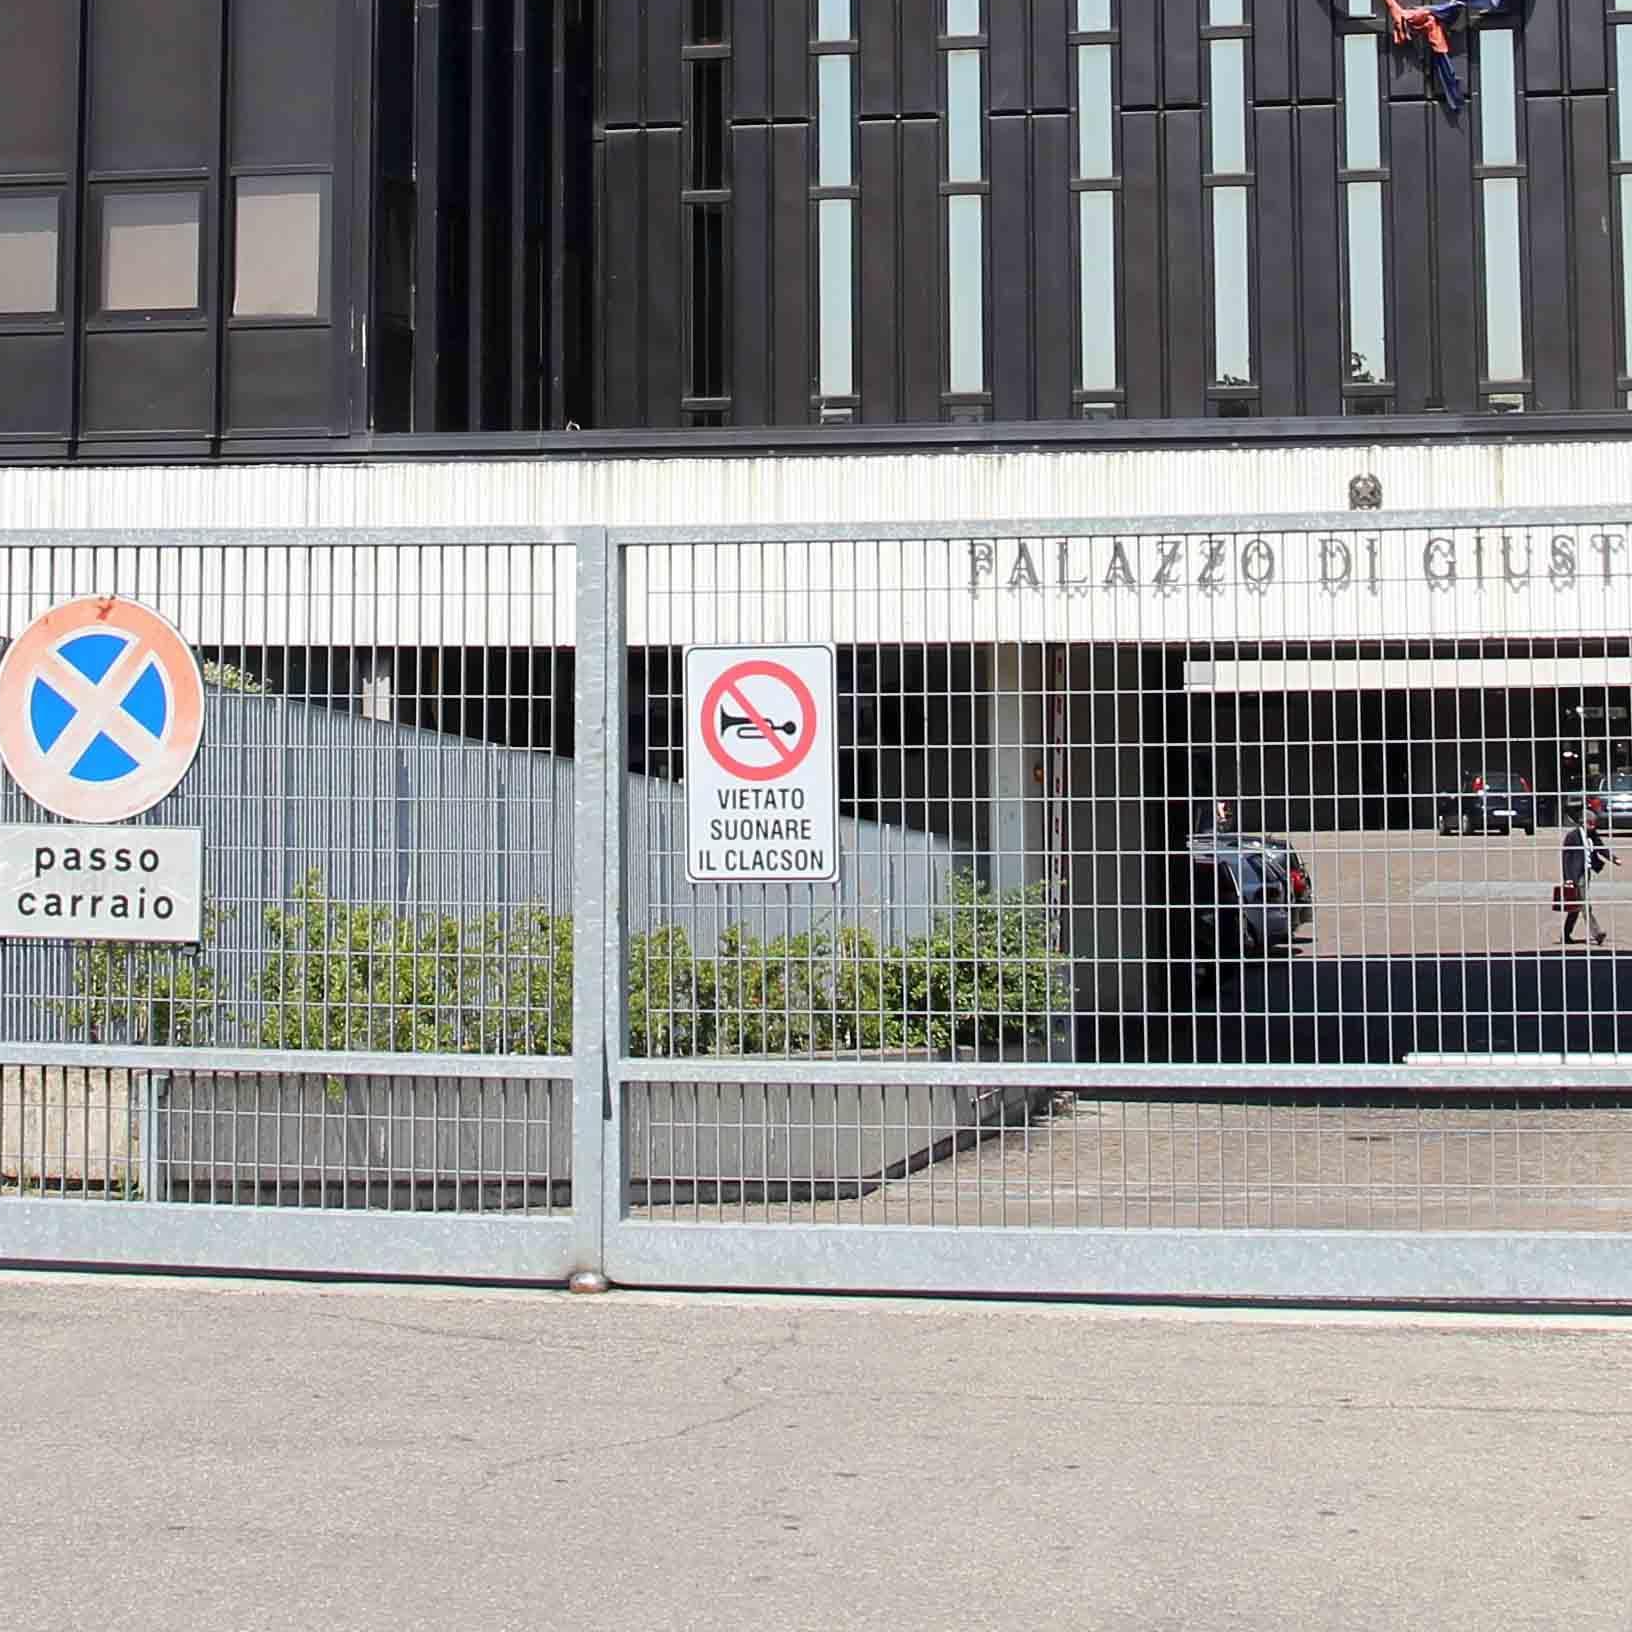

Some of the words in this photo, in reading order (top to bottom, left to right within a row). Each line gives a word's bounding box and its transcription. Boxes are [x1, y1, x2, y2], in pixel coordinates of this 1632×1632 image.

[966, 538, 1276, 590] PALAZZO
[1317, 535, 1381, 590] DI
[717, 787, 805, 810] VIETATO
[710, 818, 812, 841] SUONARE
[34, 845, 160, 878] passo
[698, 849, 719, 871] IL
[724, 849, 824, 872] CLACSON
[16, 887, 174, 920] carraio
